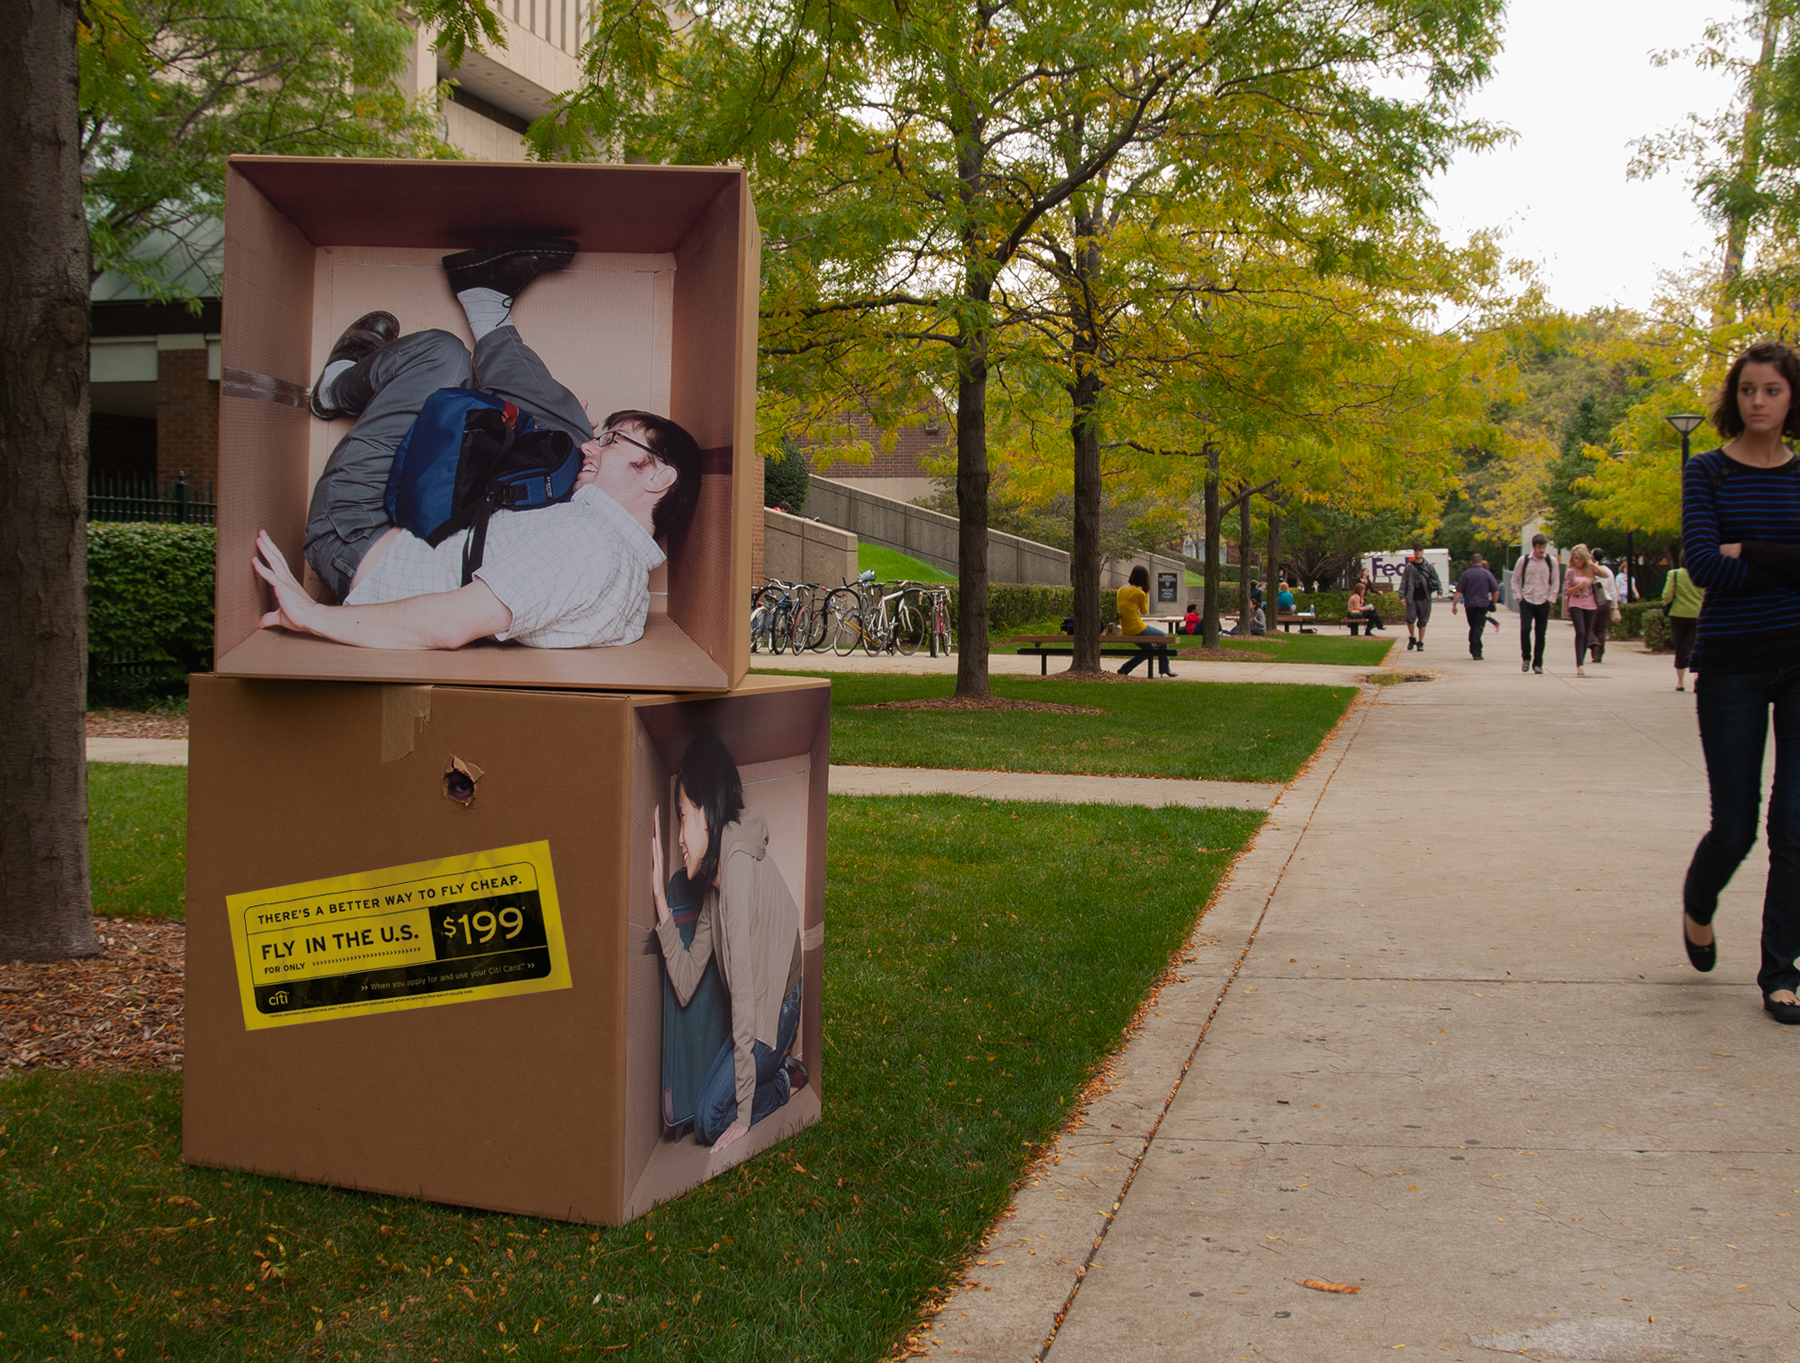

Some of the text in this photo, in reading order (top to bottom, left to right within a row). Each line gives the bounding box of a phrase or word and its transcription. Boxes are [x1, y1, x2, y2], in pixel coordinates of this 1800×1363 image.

[1372, 556, 1436, 576] Fed
[258, 875, 522, 925] THERE'S A BETTER WAY TO FLY CHEAP.
[261, 924, 419, 960] FLY IN THE U.S.
[264, 962, 306, 975] FOR ONLY
[370, 983, 390, 991] When
[392, 981, 405, 990] you
[407, 975, 426, 986] apply
[428, 974, 438, 983] for
[440, 973, 454, 982] and
[456, 971, 468, 980] use
[469, 969, 486, 979] your
[488, 965, 501, 975] Citi
